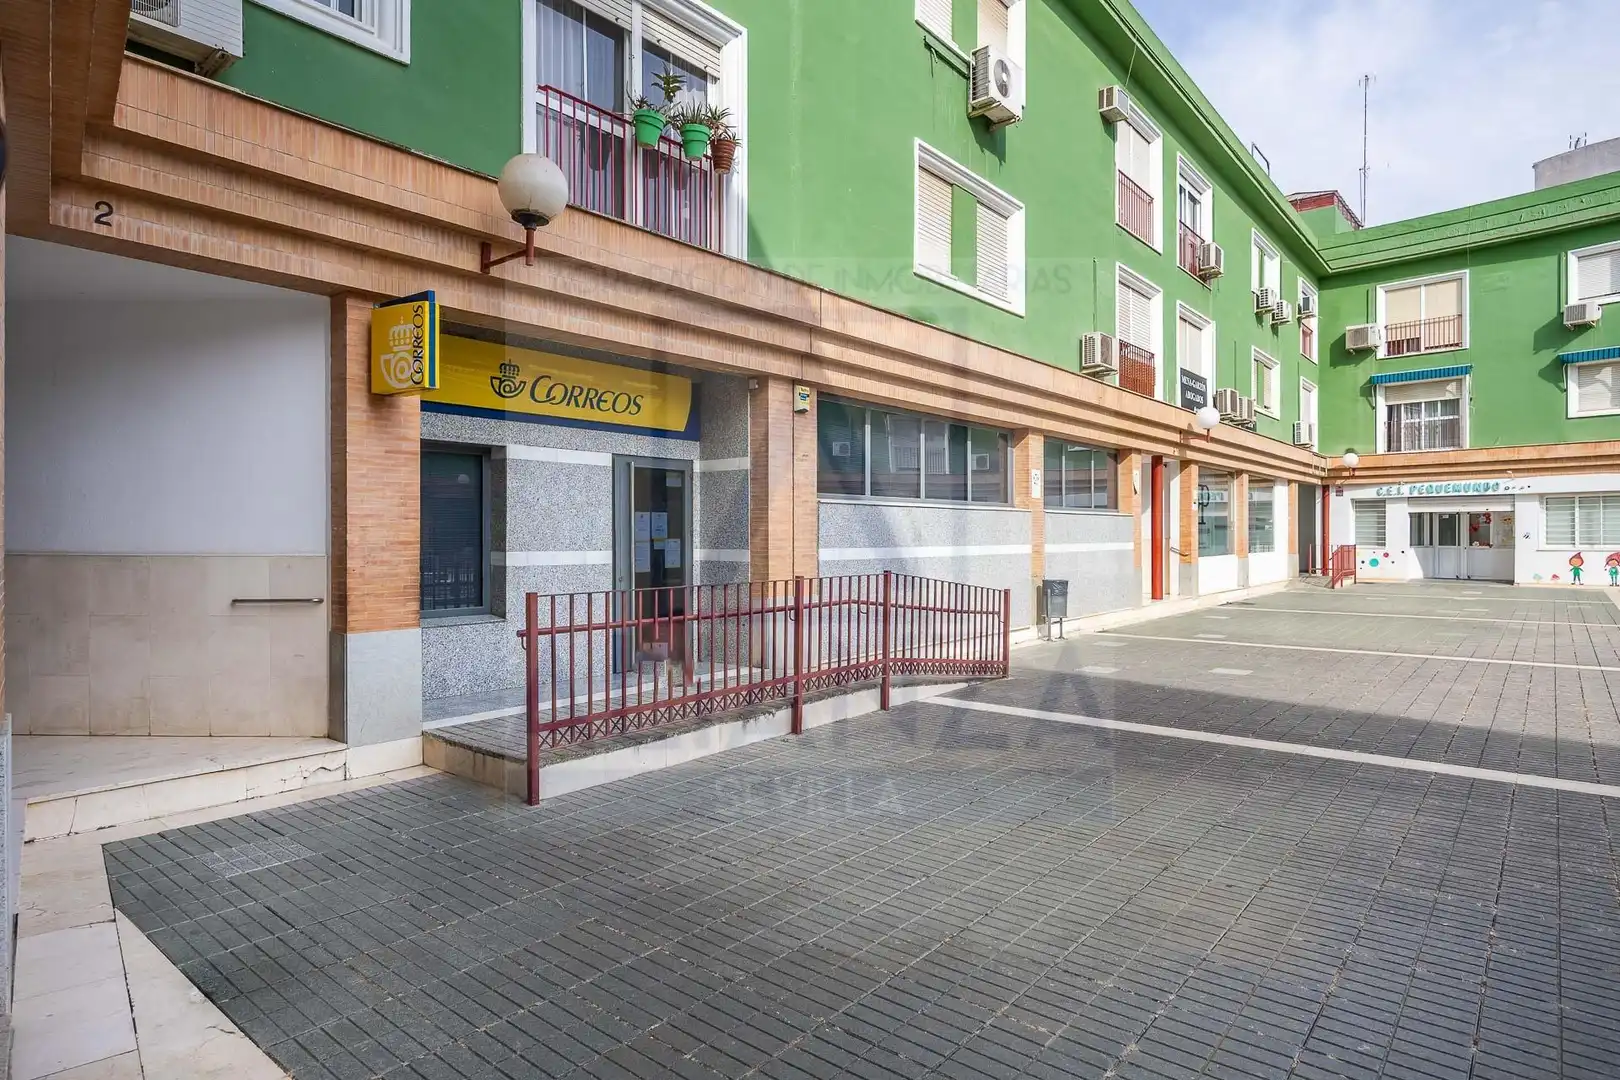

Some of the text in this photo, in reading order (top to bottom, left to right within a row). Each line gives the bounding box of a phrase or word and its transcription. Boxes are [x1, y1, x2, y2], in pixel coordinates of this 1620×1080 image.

[94, 200, 113, 227] 2
[410, 304, 424, 385] CORREOS
[529, 374, 644, 416] CORREOS
[1409, 481, 1500, 496] PEQUEMUNDO
